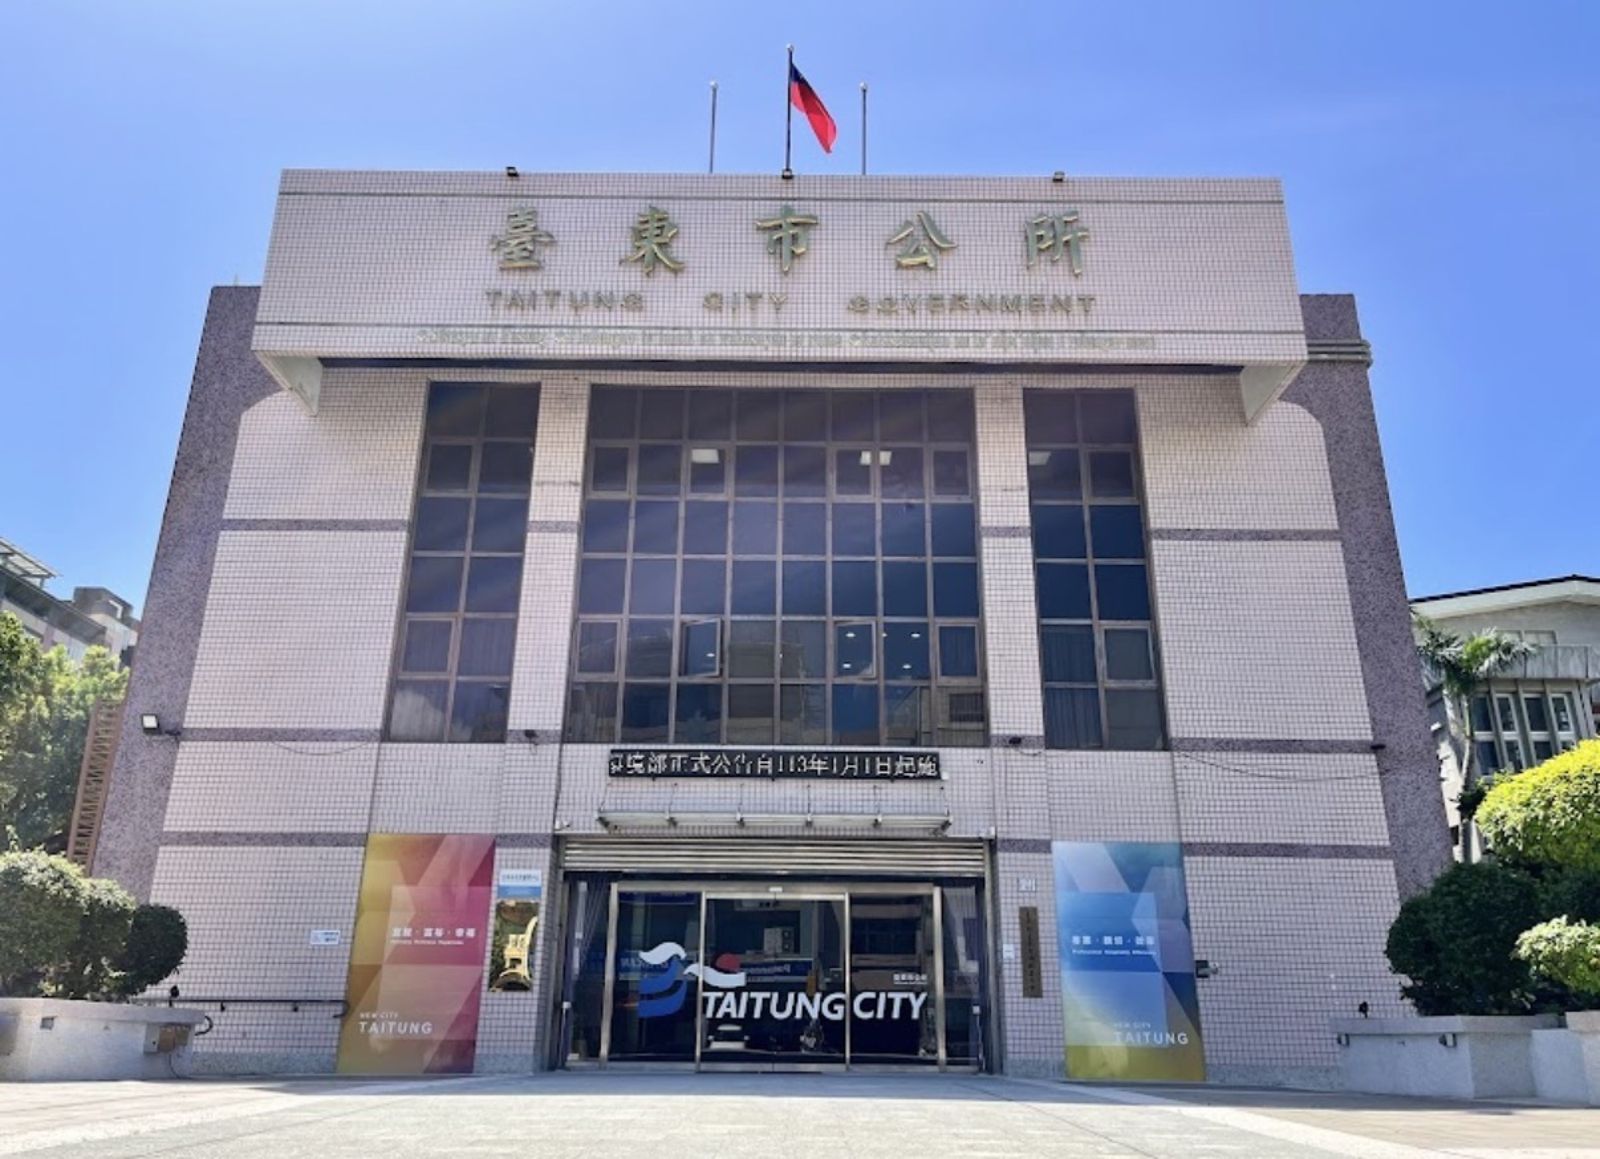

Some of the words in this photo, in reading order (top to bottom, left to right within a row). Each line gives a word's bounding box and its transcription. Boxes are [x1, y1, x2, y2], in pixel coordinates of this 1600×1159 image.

[490, 205, 1091, 278] 臺東市公所
[486, 290, 644, 312] TAITUNG
[703, 292, 788, 313] CITY
[847, 294, 1098, 315] GOVERNMENT
[703, 991, 845, 1020] TAITUNG
[853, 991, 928, 1020] CITY
[359, 1021, 433, 1034] TAITUNG
[1113, 1031, 1189, 1045] TAITUNG
